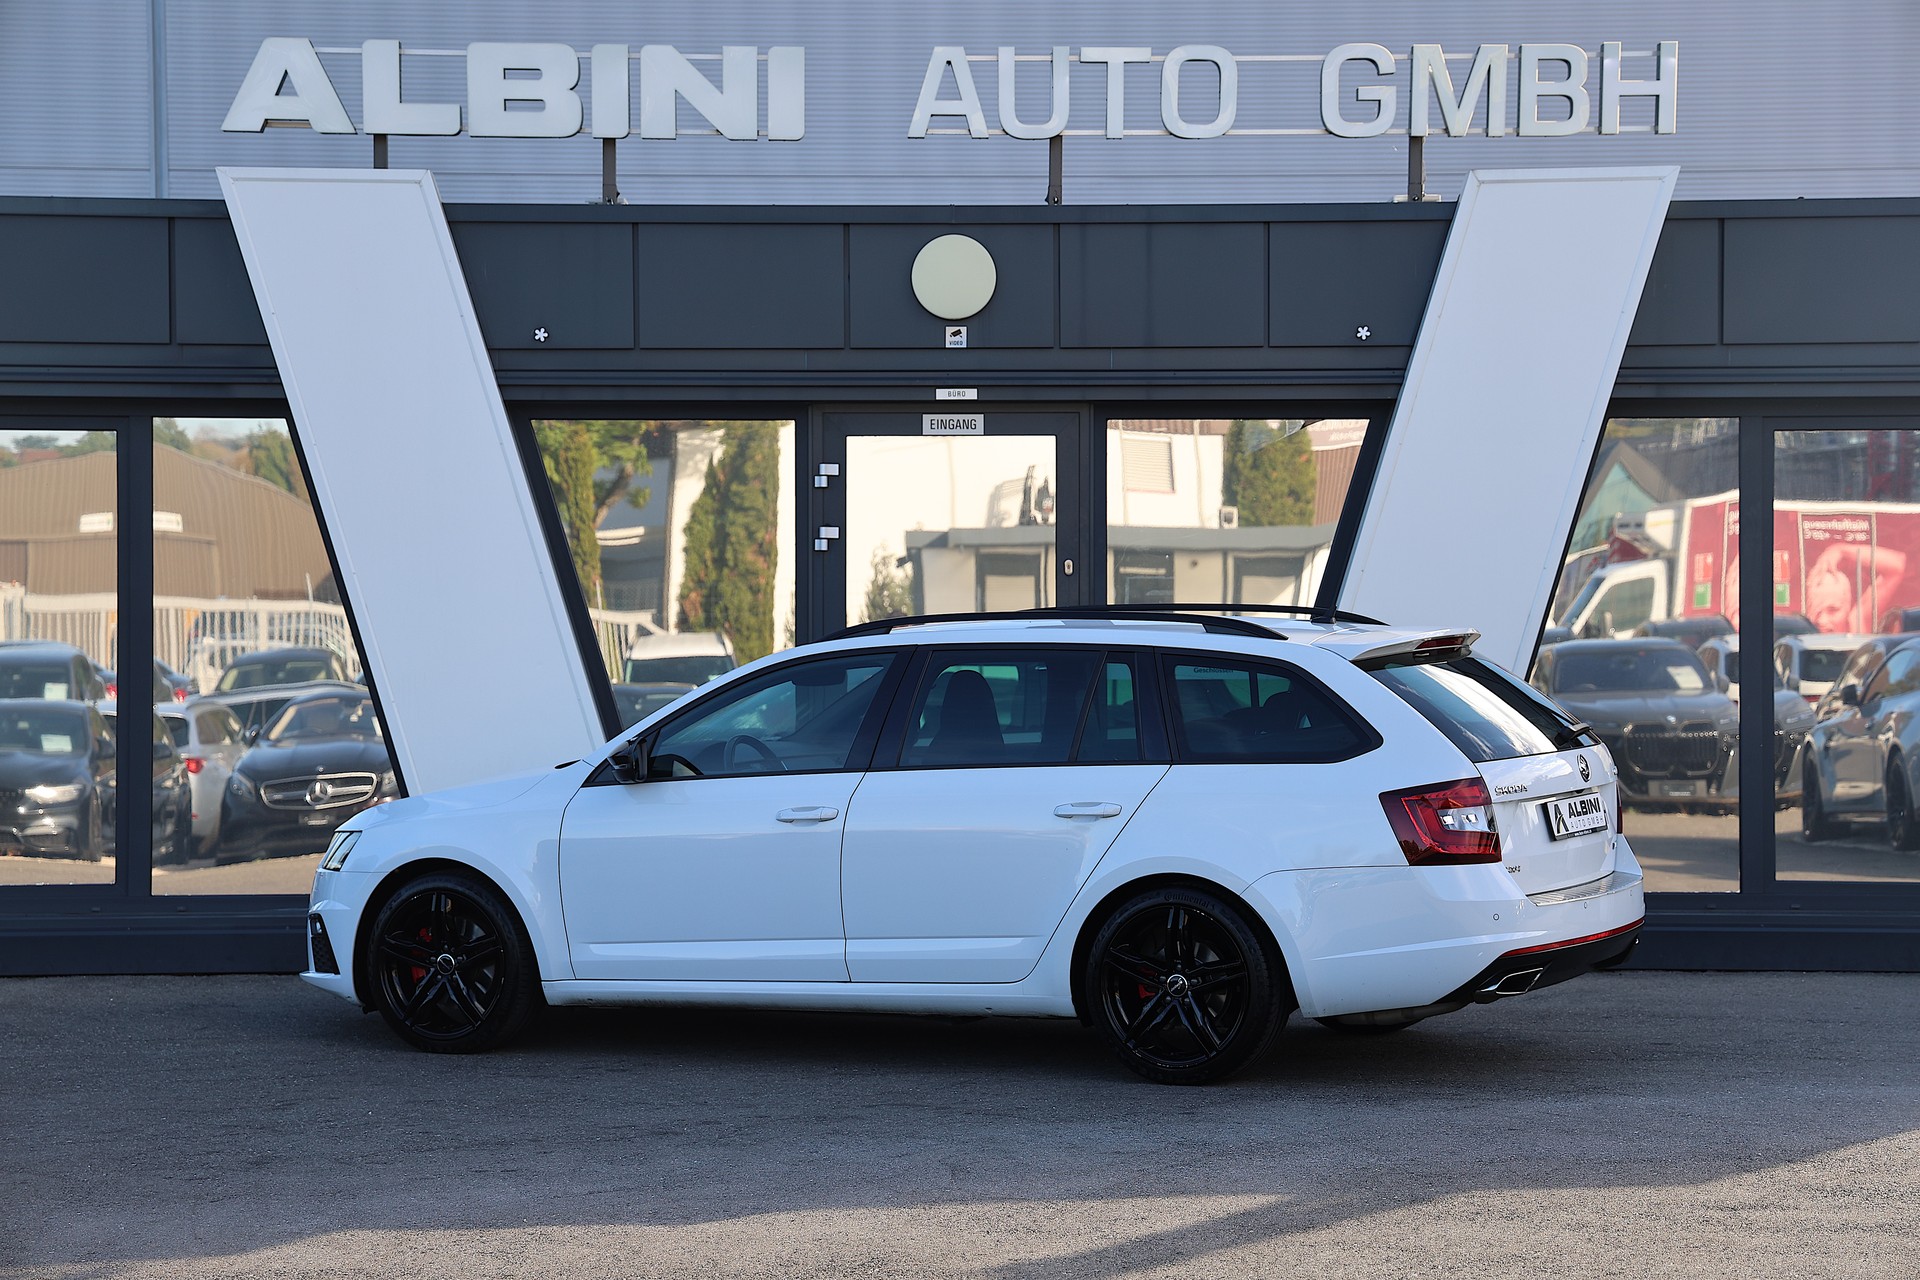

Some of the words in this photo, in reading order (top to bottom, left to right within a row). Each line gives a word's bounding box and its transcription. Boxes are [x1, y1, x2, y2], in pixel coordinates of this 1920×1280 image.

[221, 37, 805, 141] ALBINI
[907, 44, 1238, 140] AUTO
[1320, 41, 1679, 140] GMBH
[947, 390, 966, 398] BÜRO
[930, 418, 977, 430] EINGANG
[1568, 797, 1602, 818] ALBINI
[1570, 818, 1586, 830] AUTO
